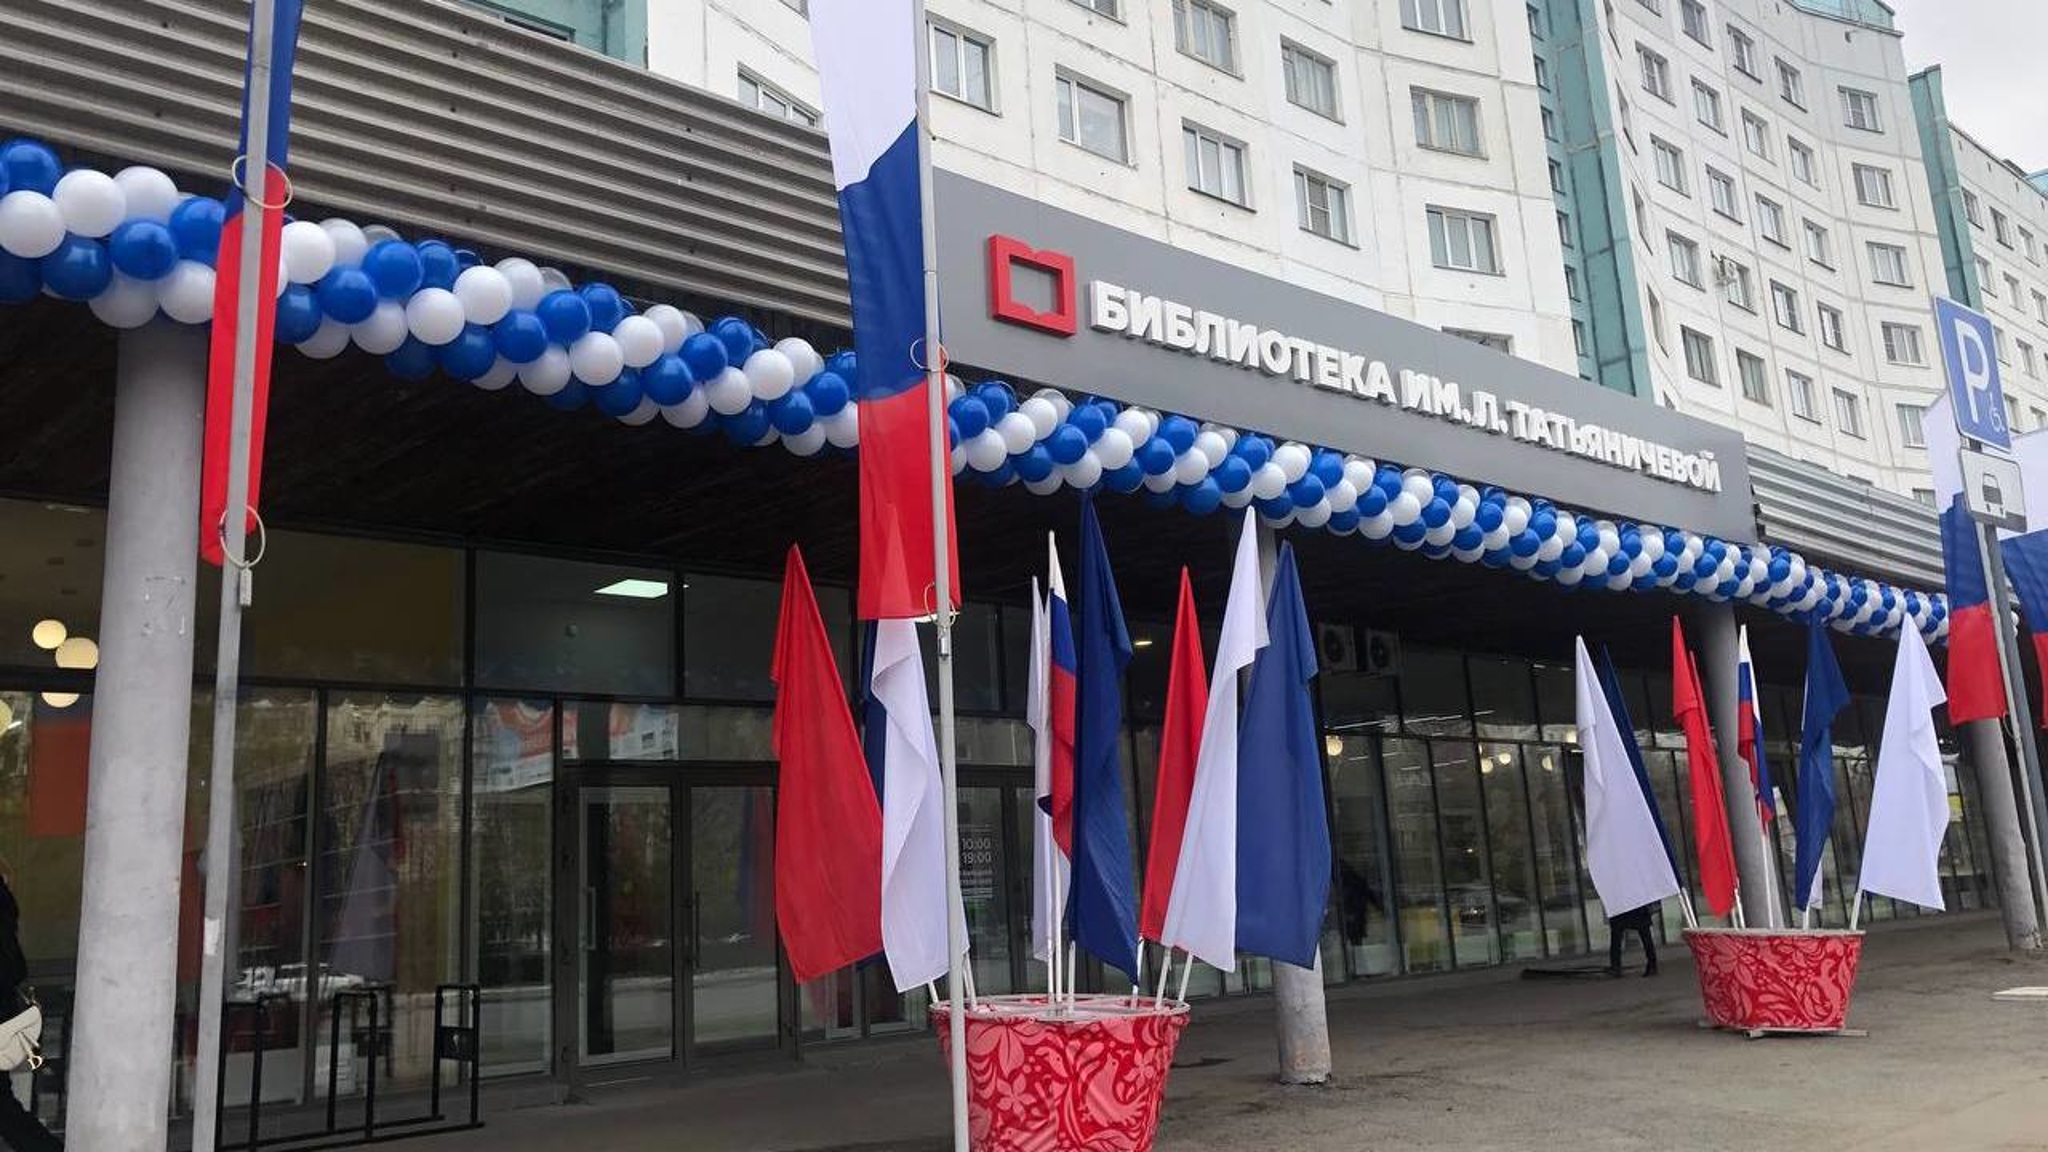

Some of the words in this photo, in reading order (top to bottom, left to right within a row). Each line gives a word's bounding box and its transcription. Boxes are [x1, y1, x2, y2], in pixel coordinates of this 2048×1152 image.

[1091, 280, 1397, 405] БИБЛИОТЕКА
[1506, 401, 1722, 492] ТАТЬЯНИЧЕВОЙ
[1954, 318, 1990, 424] P
